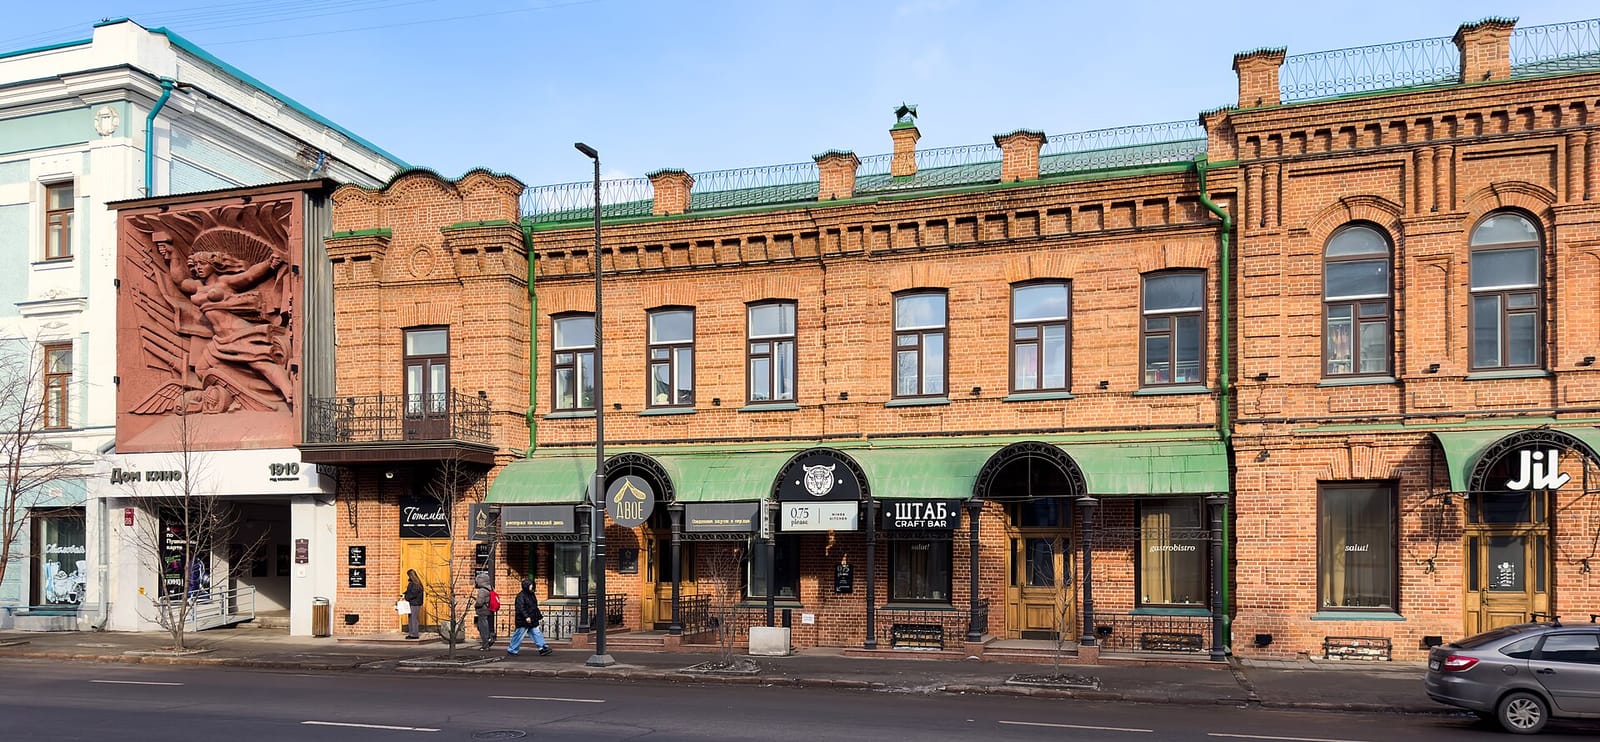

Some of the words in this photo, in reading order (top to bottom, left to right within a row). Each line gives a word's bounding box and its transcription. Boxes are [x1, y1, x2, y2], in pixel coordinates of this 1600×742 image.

[110, 468, 141, 485] Дом
[146, 470, 182, 482] кино
[269, 462, 300, 476] 1910
[1506, 449, 1571, 490] Jil
[895, 502, 947, 520] ШТАБ
[790, 518, 808, 528] please
[1150, 544, 1196, 552] gastrobistro
